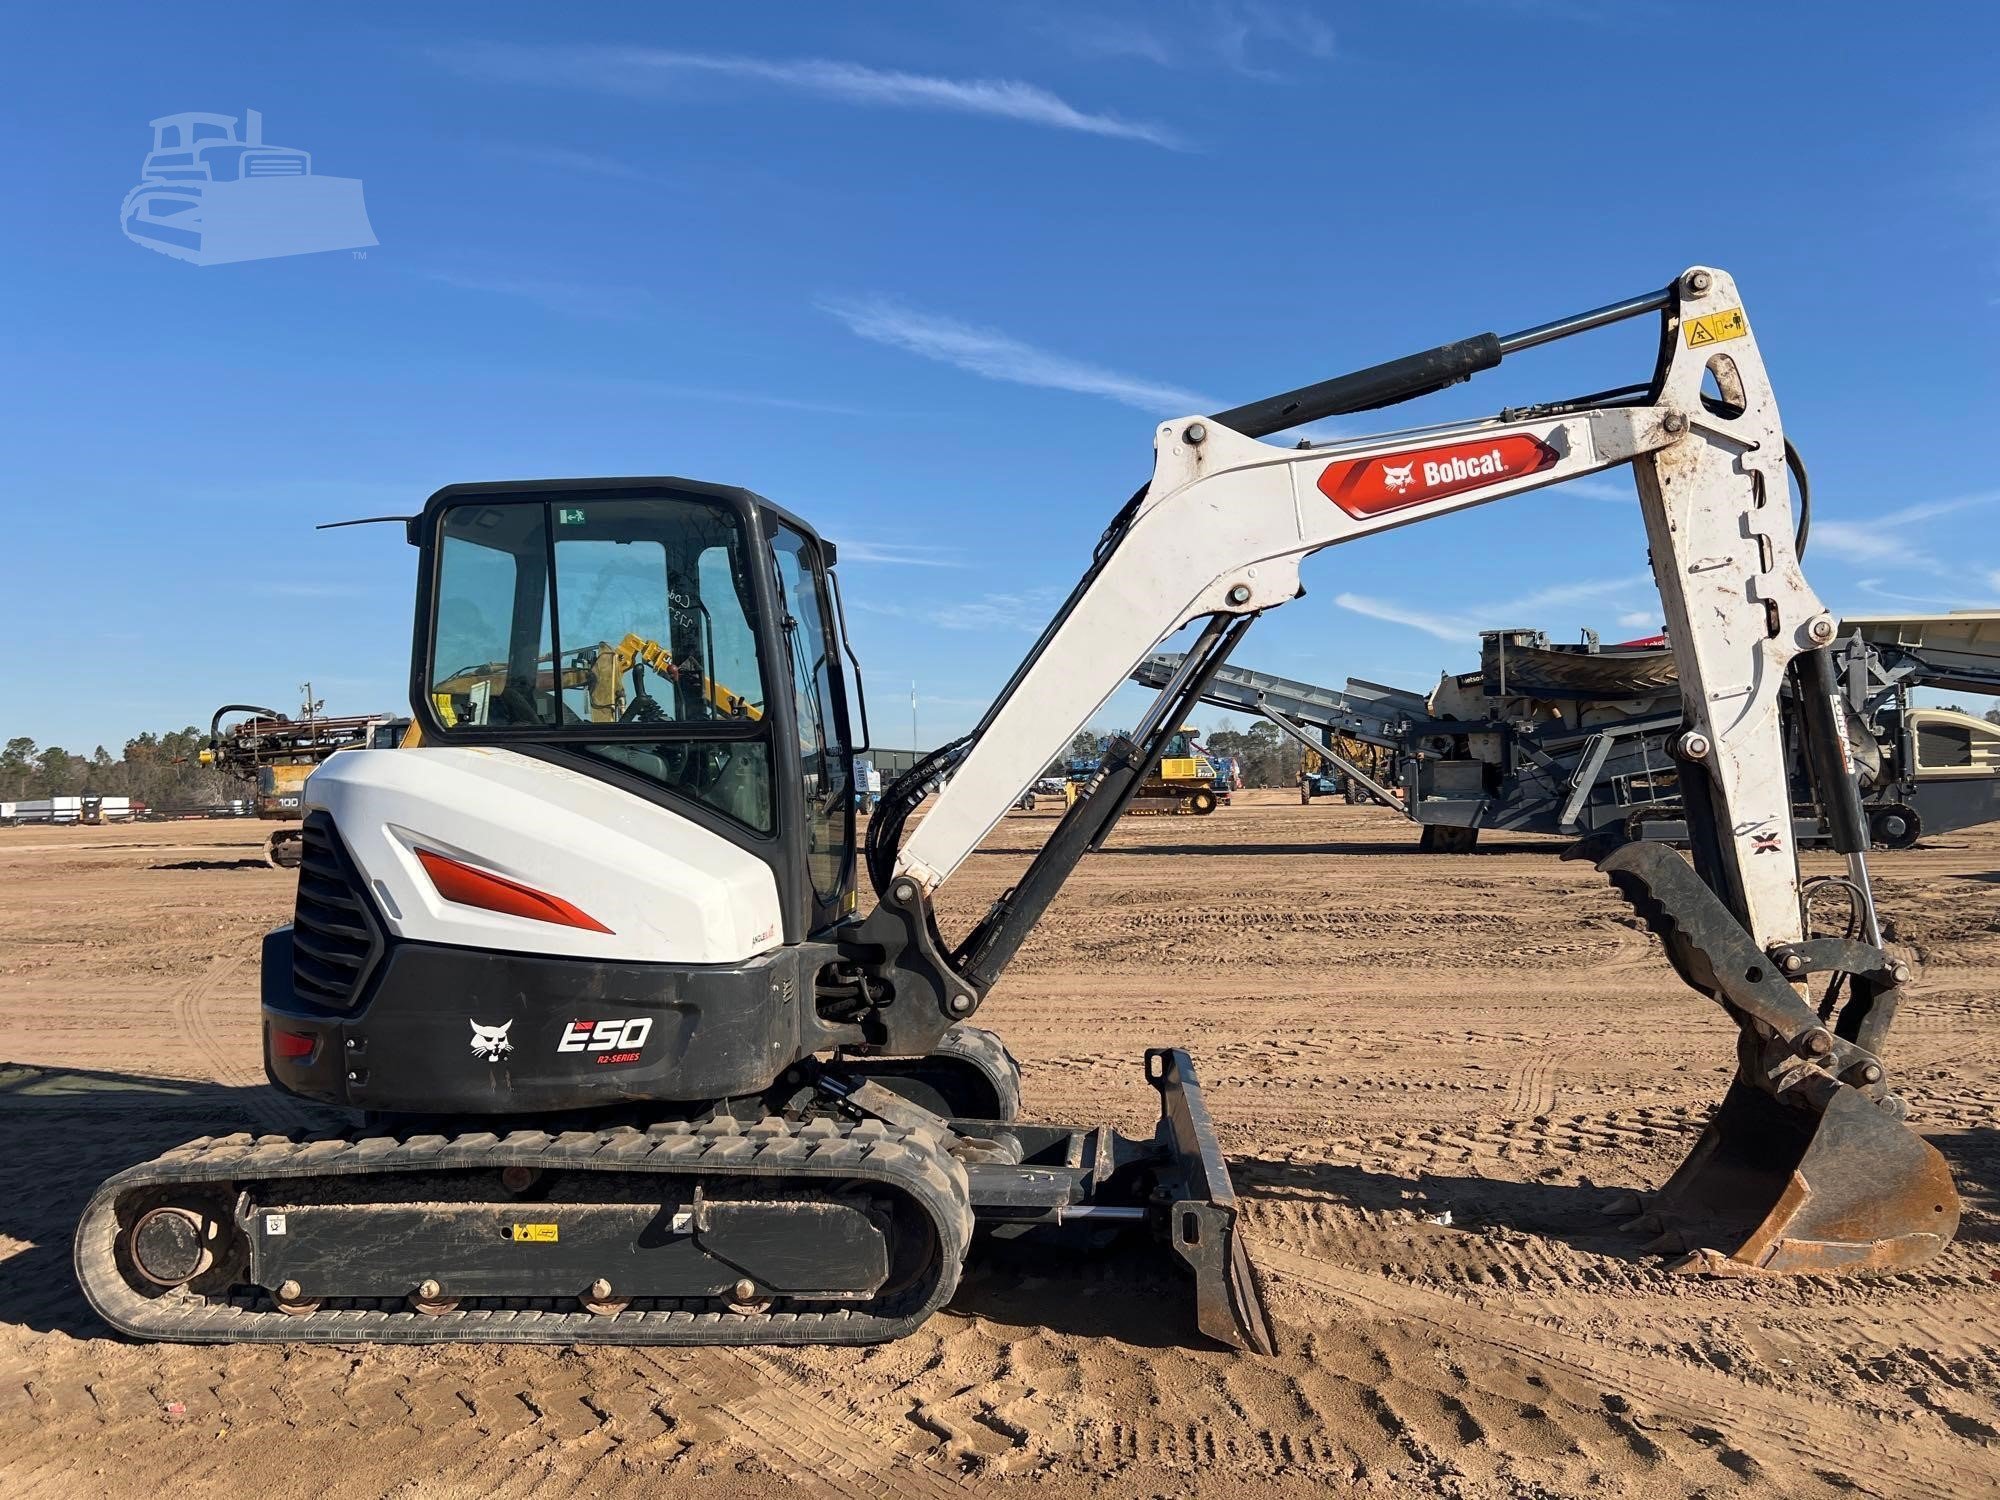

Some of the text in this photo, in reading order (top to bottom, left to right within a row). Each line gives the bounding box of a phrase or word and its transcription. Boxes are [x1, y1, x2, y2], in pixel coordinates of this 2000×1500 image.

[1422, 449, 1504, 487] Bobcat
[556, 1017, 653, 1053] E50
[596, 1052, 641, 1064] R2-SERIES
